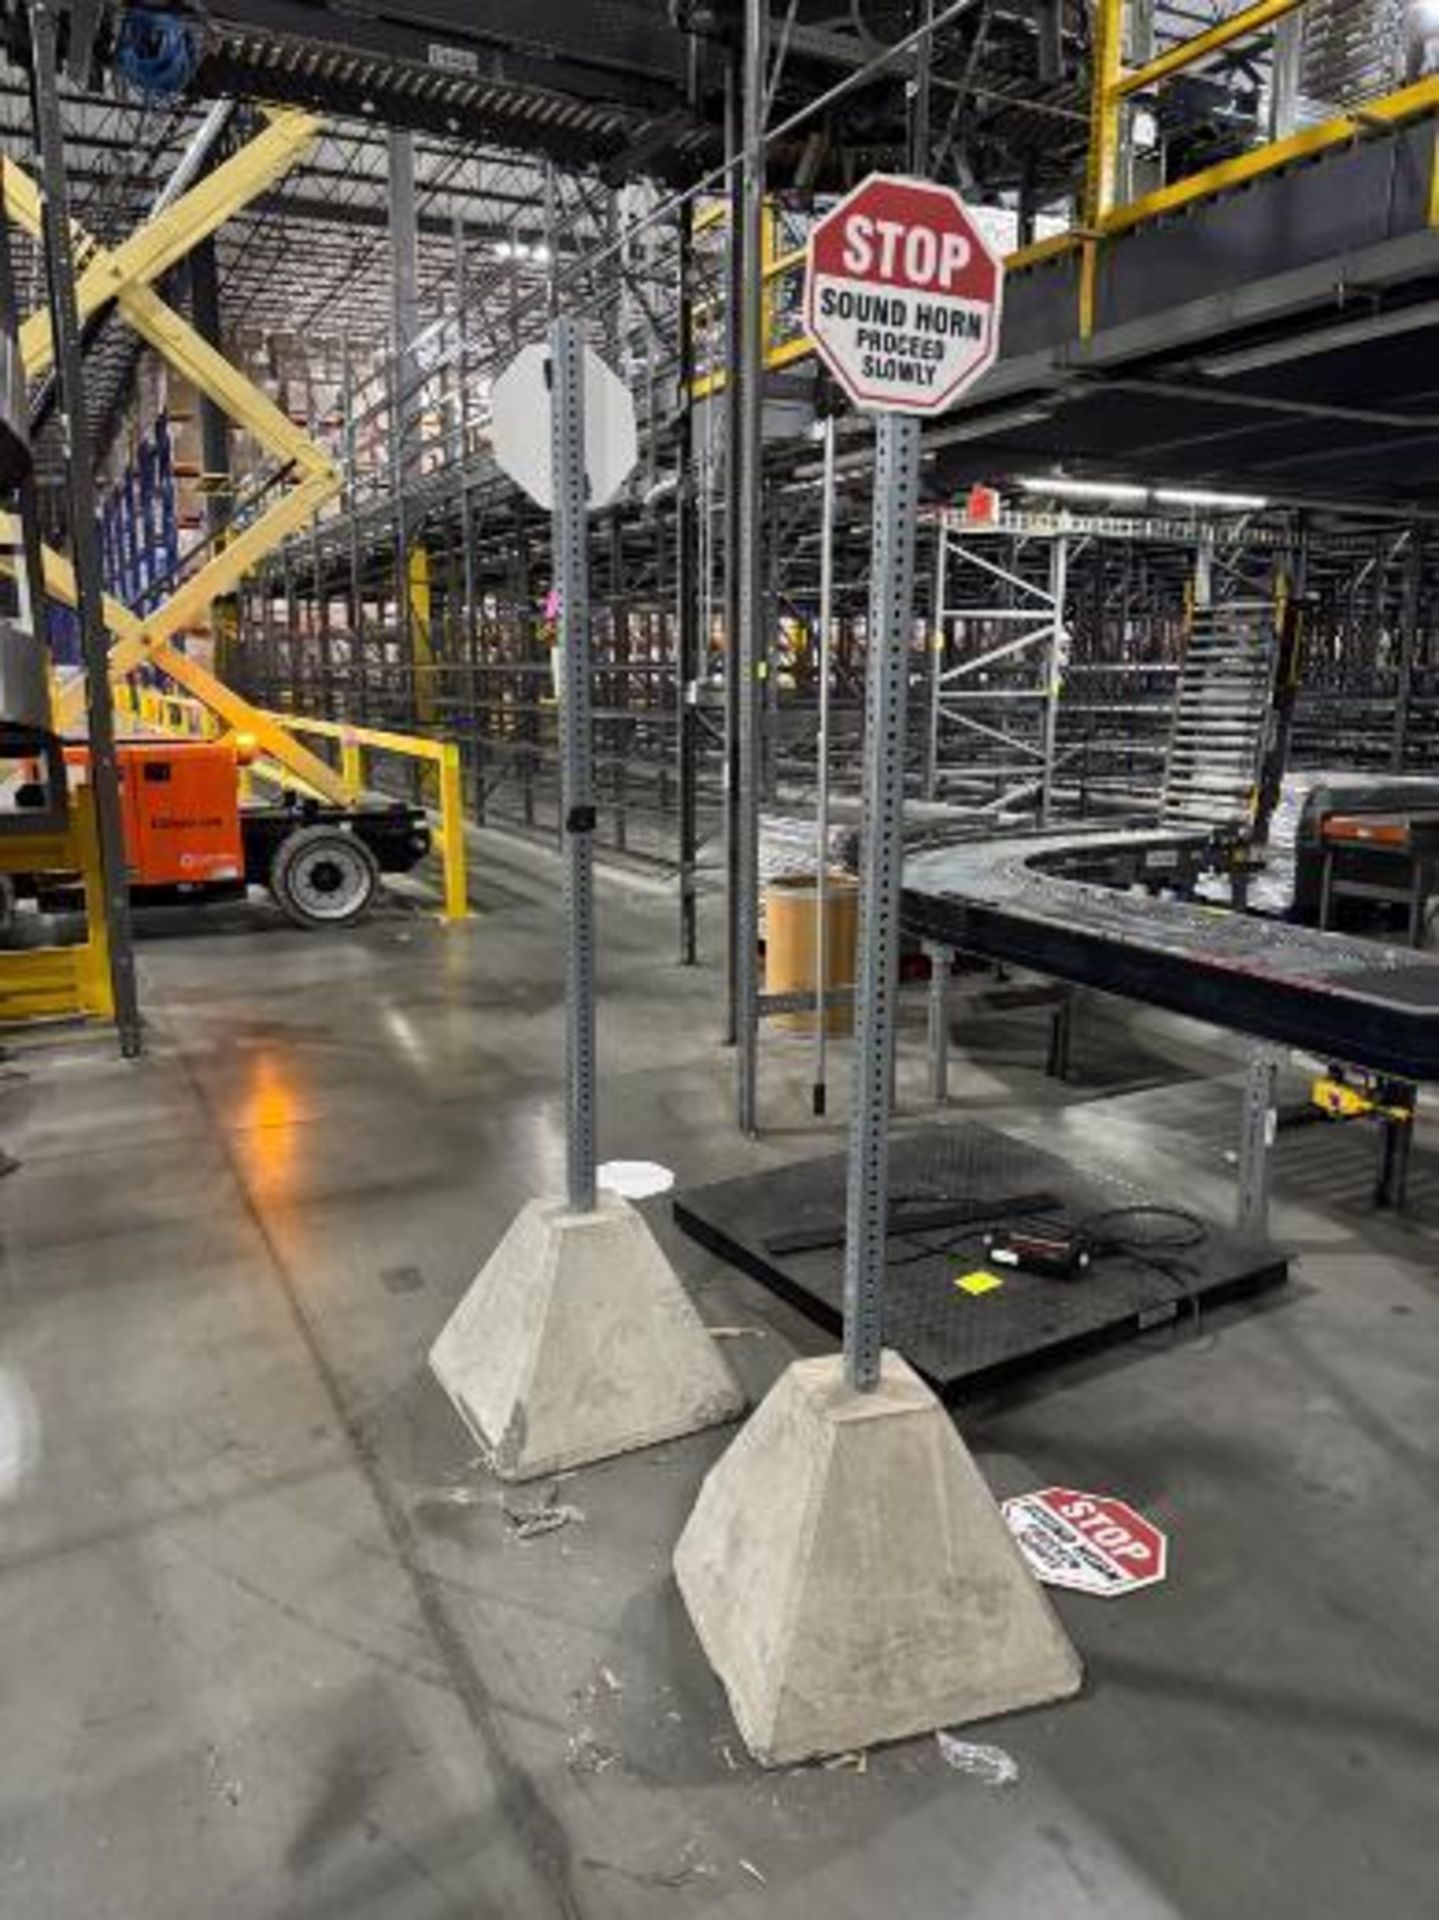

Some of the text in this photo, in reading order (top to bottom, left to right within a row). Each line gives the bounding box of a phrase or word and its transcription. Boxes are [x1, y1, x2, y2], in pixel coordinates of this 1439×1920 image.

[843, 214, 970, 287] STOP
[821, 288, 982, 340] SOUND HORN
[857, 328, 945, 361] PROCEED
[862, 355, 936, 386] SLOWLY
[1059, 1501, 1152, 1559] STOP
